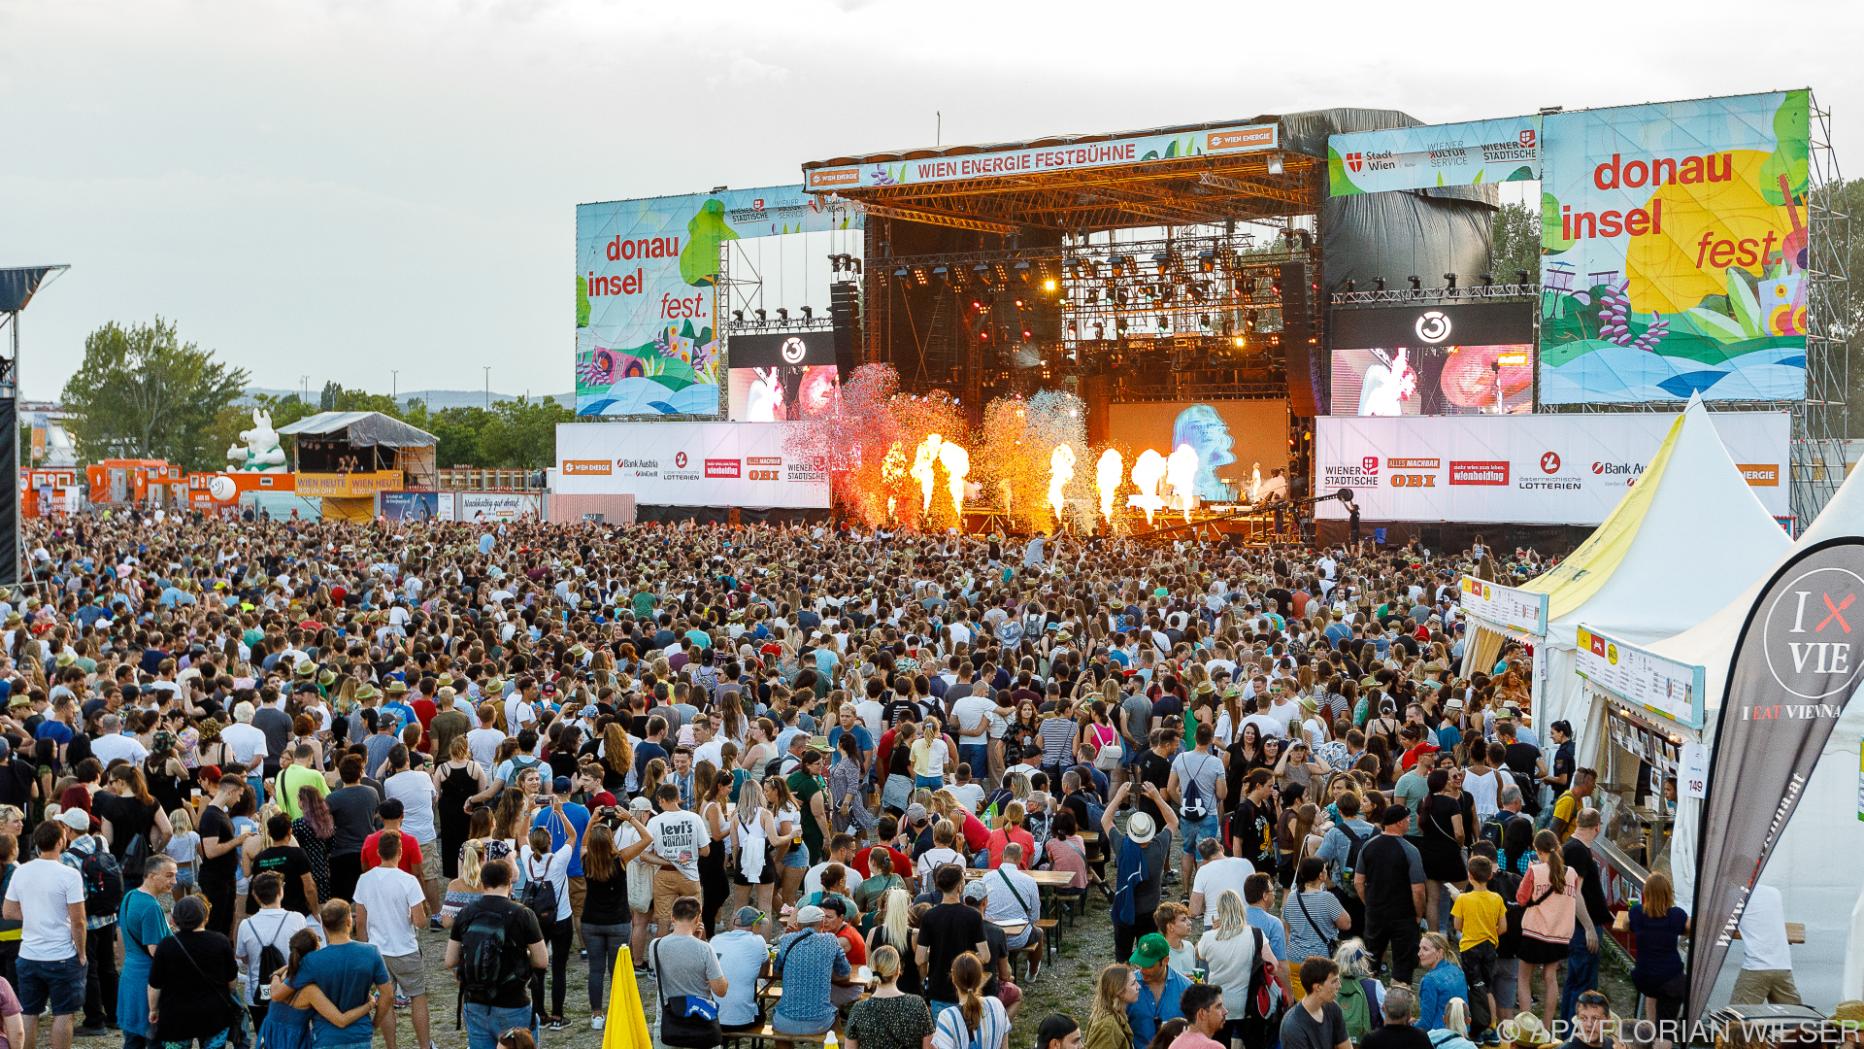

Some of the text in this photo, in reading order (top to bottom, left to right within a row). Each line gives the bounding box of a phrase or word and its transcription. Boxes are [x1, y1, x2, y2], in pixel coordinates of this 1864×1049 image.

[1224, 132, 1271, 144] WIEN ENERGIE
[1427, 141, 1464, 151] WIENER
[1480, 142, 1520, 151] WIENER
[1366, 149, 1393, 160] Stadt
[918, 143, 1136, 179] WIEN ENERGIE FESTBÜHNE
[1367, 161, 1396, 171] Wien
[1430, 157, 1468, 168] SERVICE
[1593, 153, 1733, 191] donau
[1562, 198, 1662, 241] insel
[606, 234, 679, 262] donau
[1696, 230, 1783, 270] fest.
[588, 268, 643, 297] insel
[660, 292, 708, 320] fest.
[623, 459, 638, 468] Bank
[1605, 462, 1631, 475] Bank
[1325, 466, 1361, 475] WIENER
[1454, 471, 1504, 482] wienholding
[1743, 470, 1776, 480] NERGIE
[298, 478, 318, 487] WIEN
[352, 478, 373, 487] WIEN
[1391, 474, 1437, 488] OBI
[1519, 482, 1582, 490] LOTTERIEN
[1789, 590, 1812, 633] I
[1788, 642, 1851, 674] VIE
[1743, 703, 1841, 721] I EAT VIENNA
[1689, 780, 1703, 792] 149
[660, 820, 693, 836] levi's
